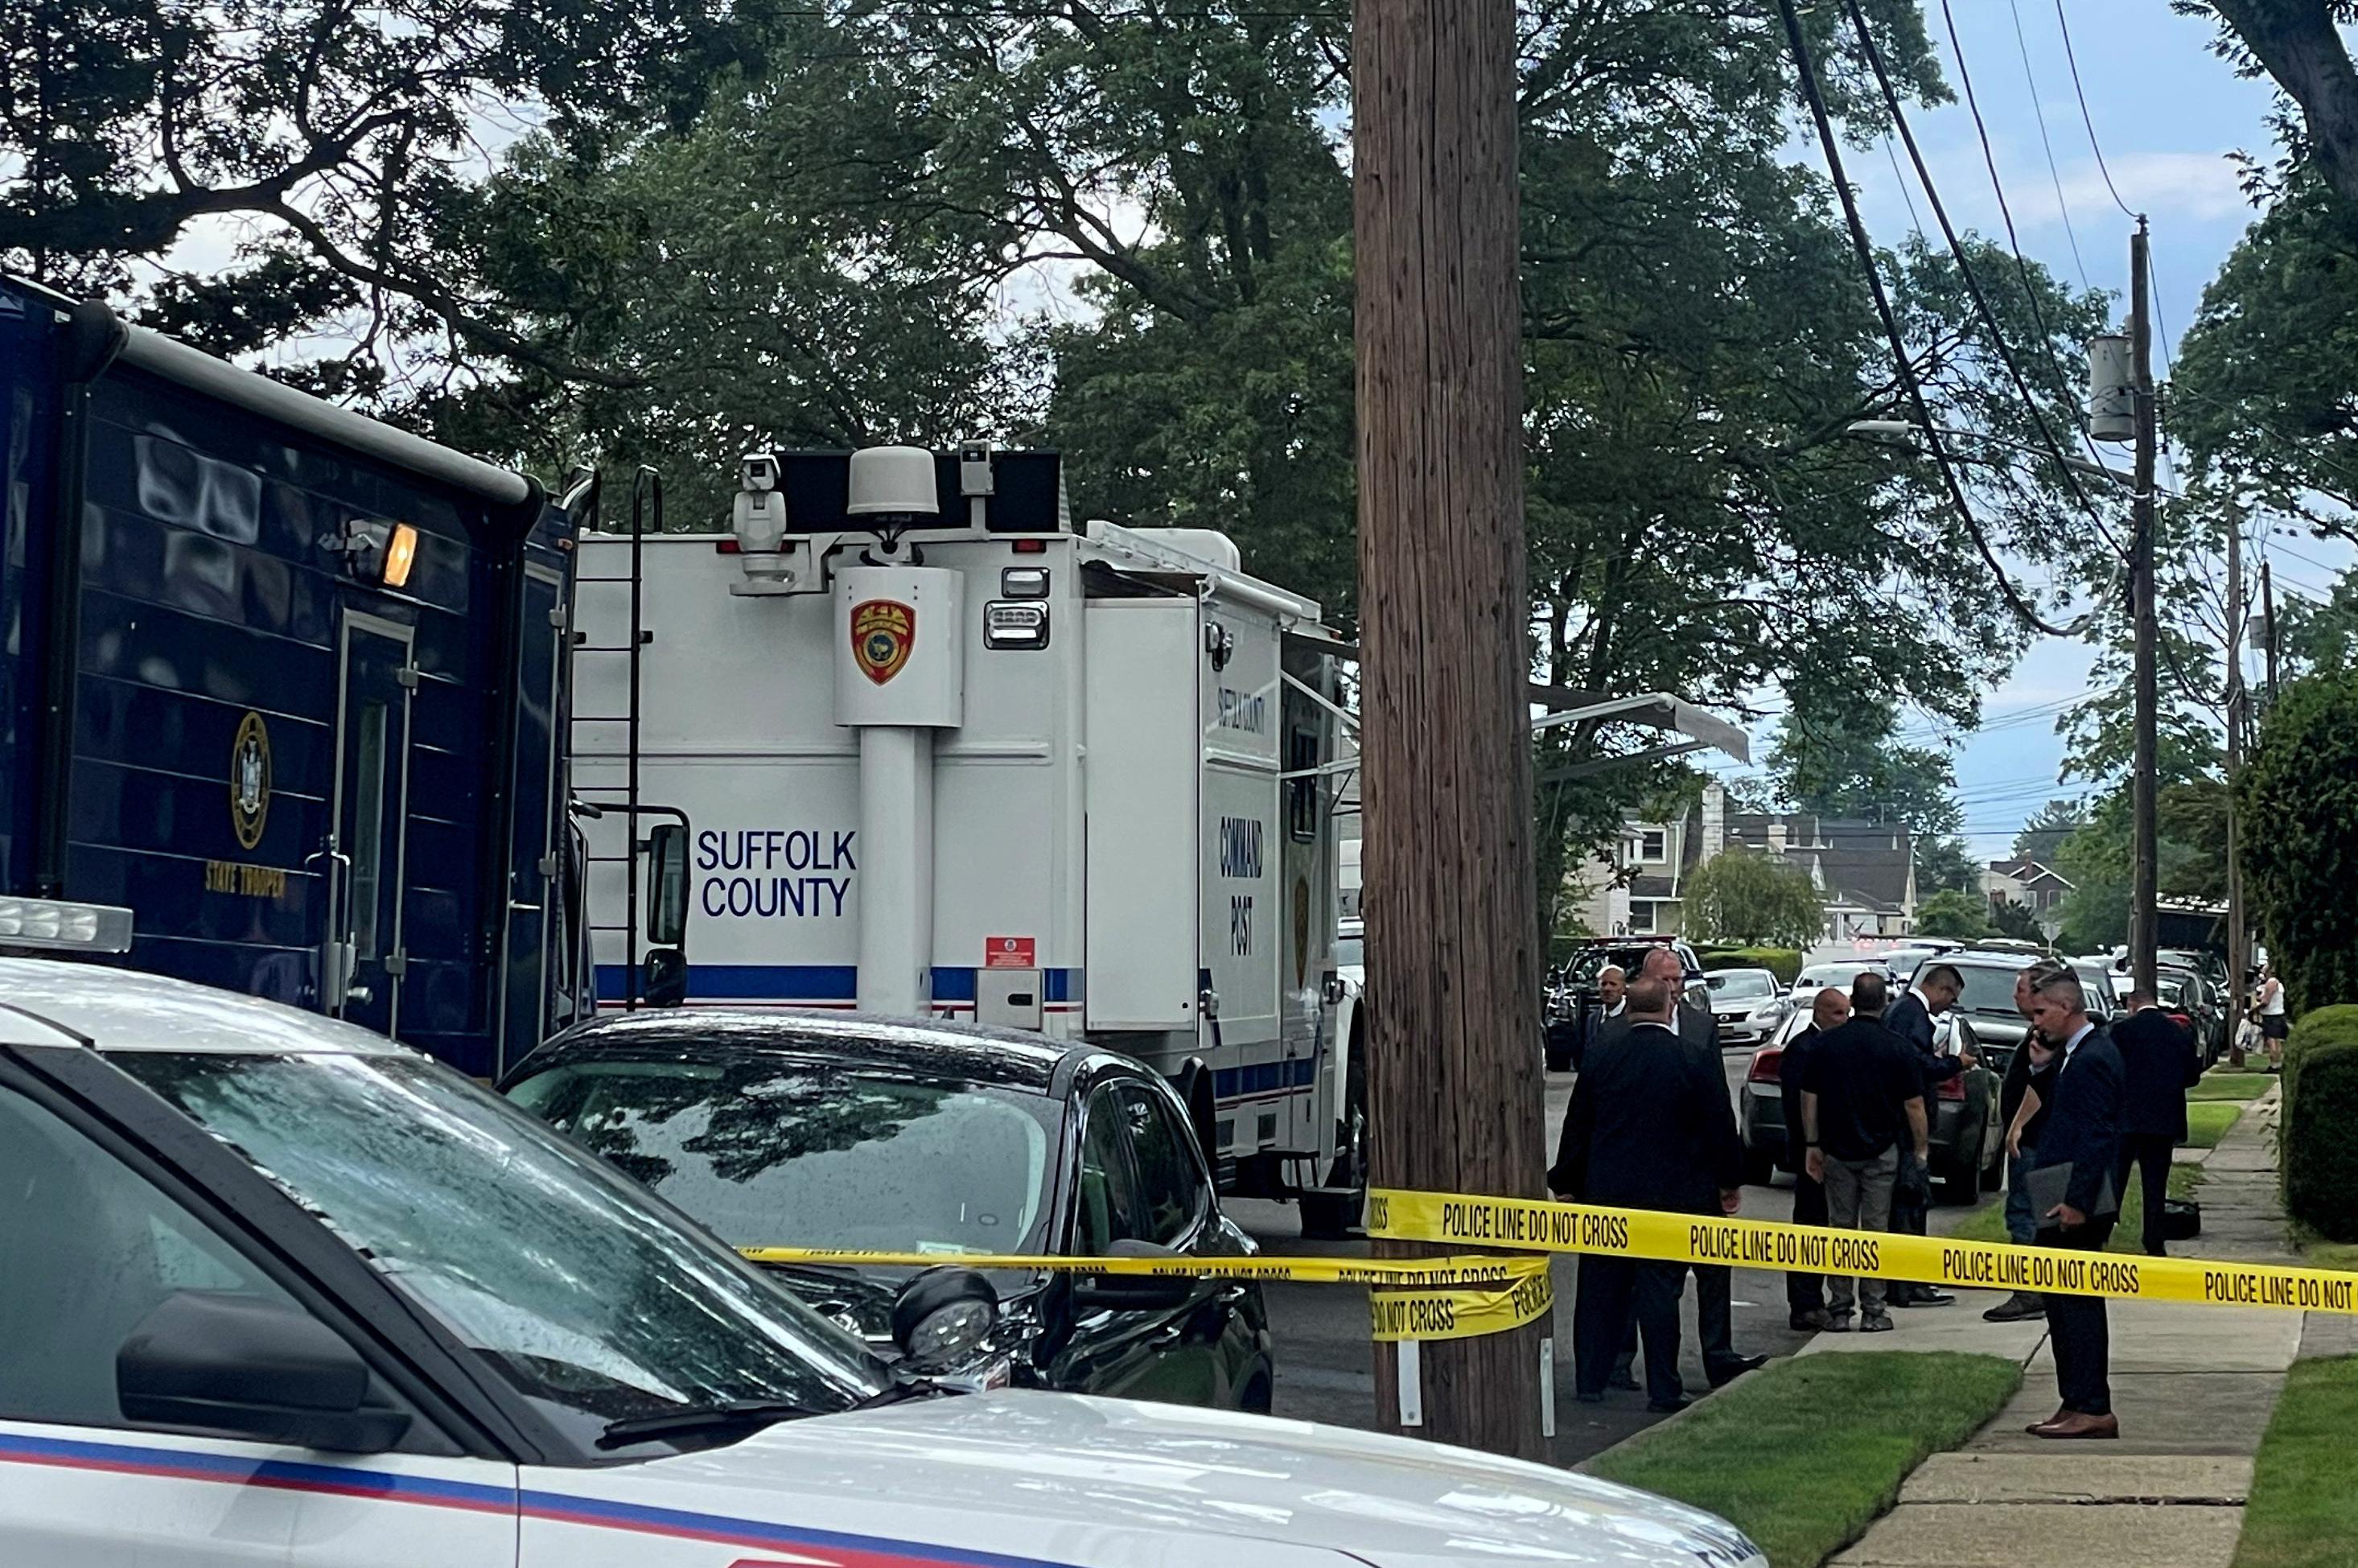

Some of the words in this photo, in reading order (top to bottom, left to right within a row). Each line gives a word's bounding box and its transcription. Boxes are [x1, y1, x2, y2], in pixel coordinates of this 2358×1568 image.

[697, 830, 856, 870] SUFFOLK
[1220, 816, 1262, 878] COMMAND
[205, 860, 236, 893] STATE
[702, 877, 851, 917] COUNTY
[1231, 895, 1252, 956] POST
[1442, 1203, 1490, 1238] POLICE
[1495, 1206, 1524, 1241] LINE
[1529, 1209, 1548, 1242] DO
[1552, 1211, 1578, 1245] NOT
[1582, 1213, 1628, 1249] CROSS
[1690, 1224, 1739, 1259] POLICE
[1743, 1229, 1772, 1262] LINE
[1777, 1233, 1796, 1264] DO
[1801, 1234, 1828, 1266] NOT
[1832, 1237, 1879, 1271] CROSS
[1944, 1249, 1994, 1282] POLICE
[1998, 1253, 2029, 1285] LINE
[2033, 1257, 2053, 1286] DO
[2058, 1258, 2085, 1290] NOT
[2092, 1261, 2139, 1293] CROSS
[2205, 1271, 2257, 1303] POLICE
[2261, 1275, 2294, 1305] LINE
[2298, 1278, 2319, 1307] DO
[2323, 1280, 2352, 1309] NOT
[1387, 1300, 1406, 1334] NOT
[1409, 1298, 1455, 1332] CROSS
